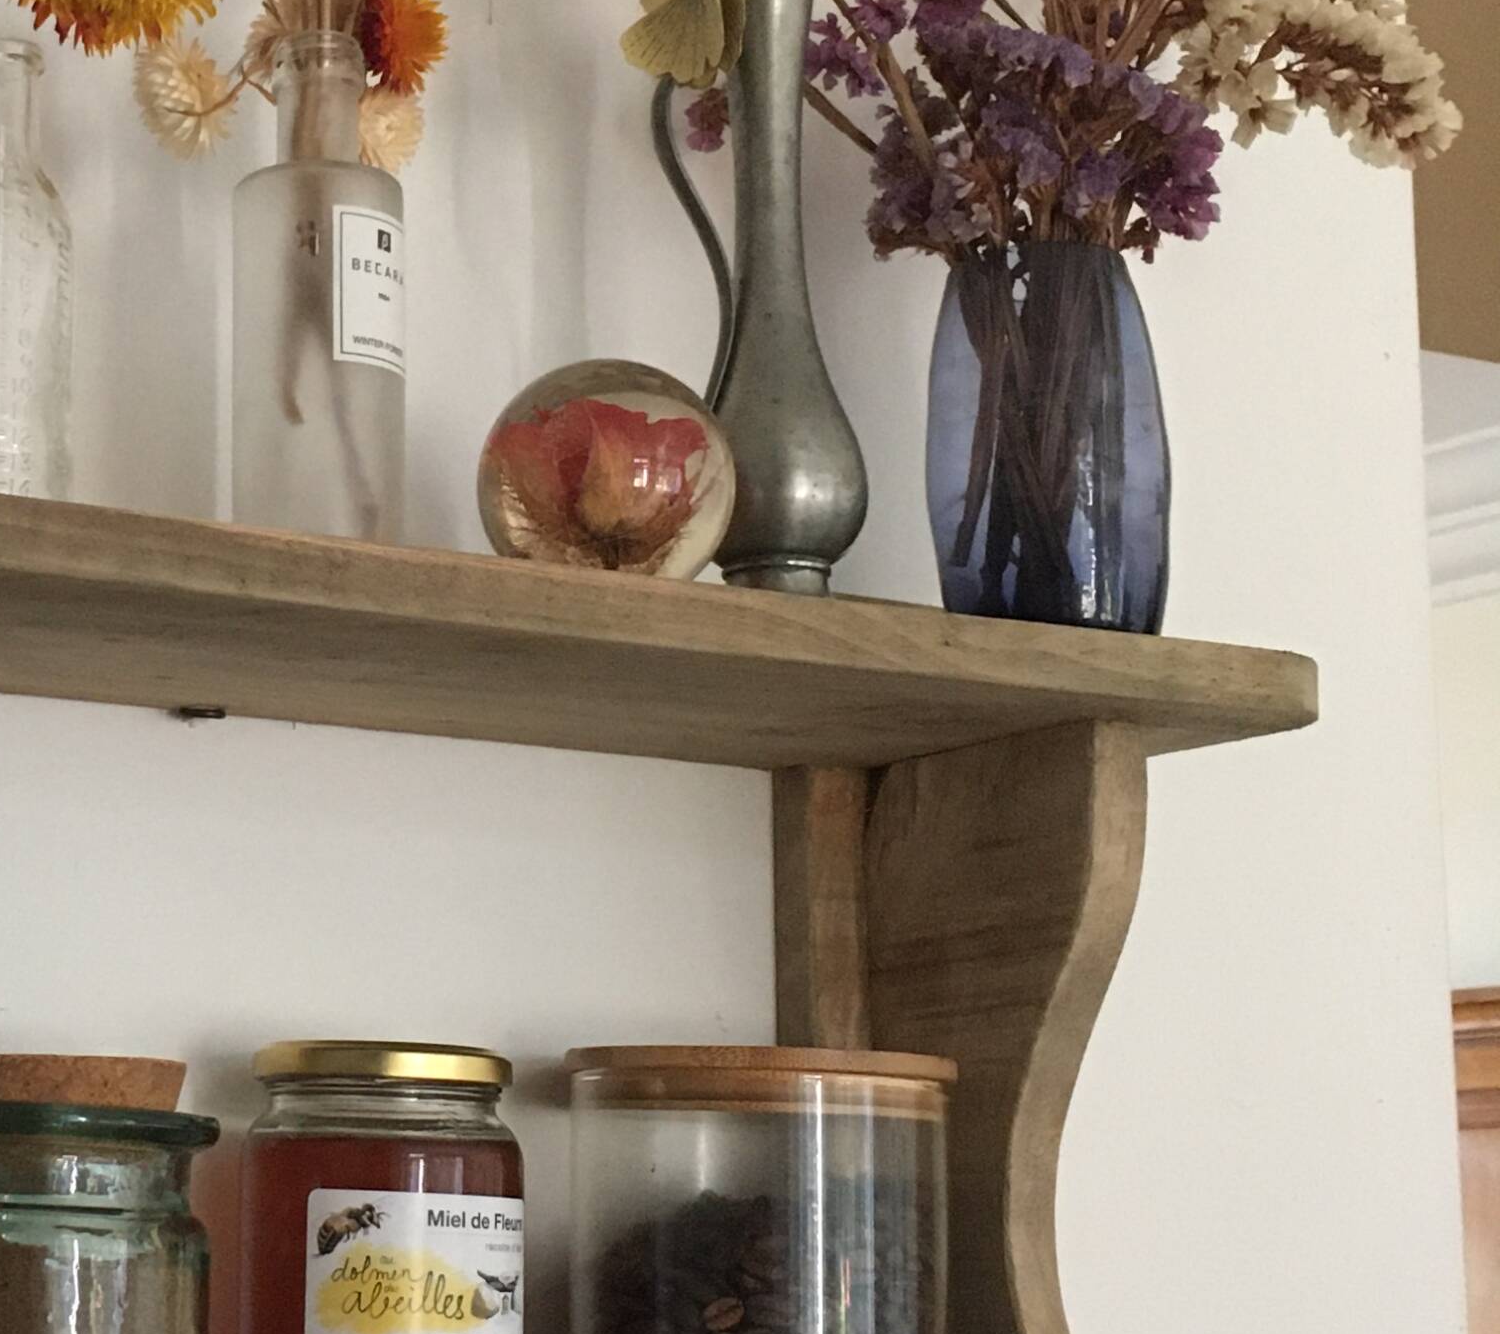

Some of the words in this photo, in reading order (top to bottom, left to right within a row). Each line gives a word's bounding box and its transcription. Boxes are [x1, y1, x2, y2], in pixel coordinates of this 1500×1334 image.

[427, 1209, 466, 1228] Miel
[471, 1212, 490, 1229] de
[495, 1213, 523, 1232] Fleur
[331, 1255, 420, 1284] dolmen
